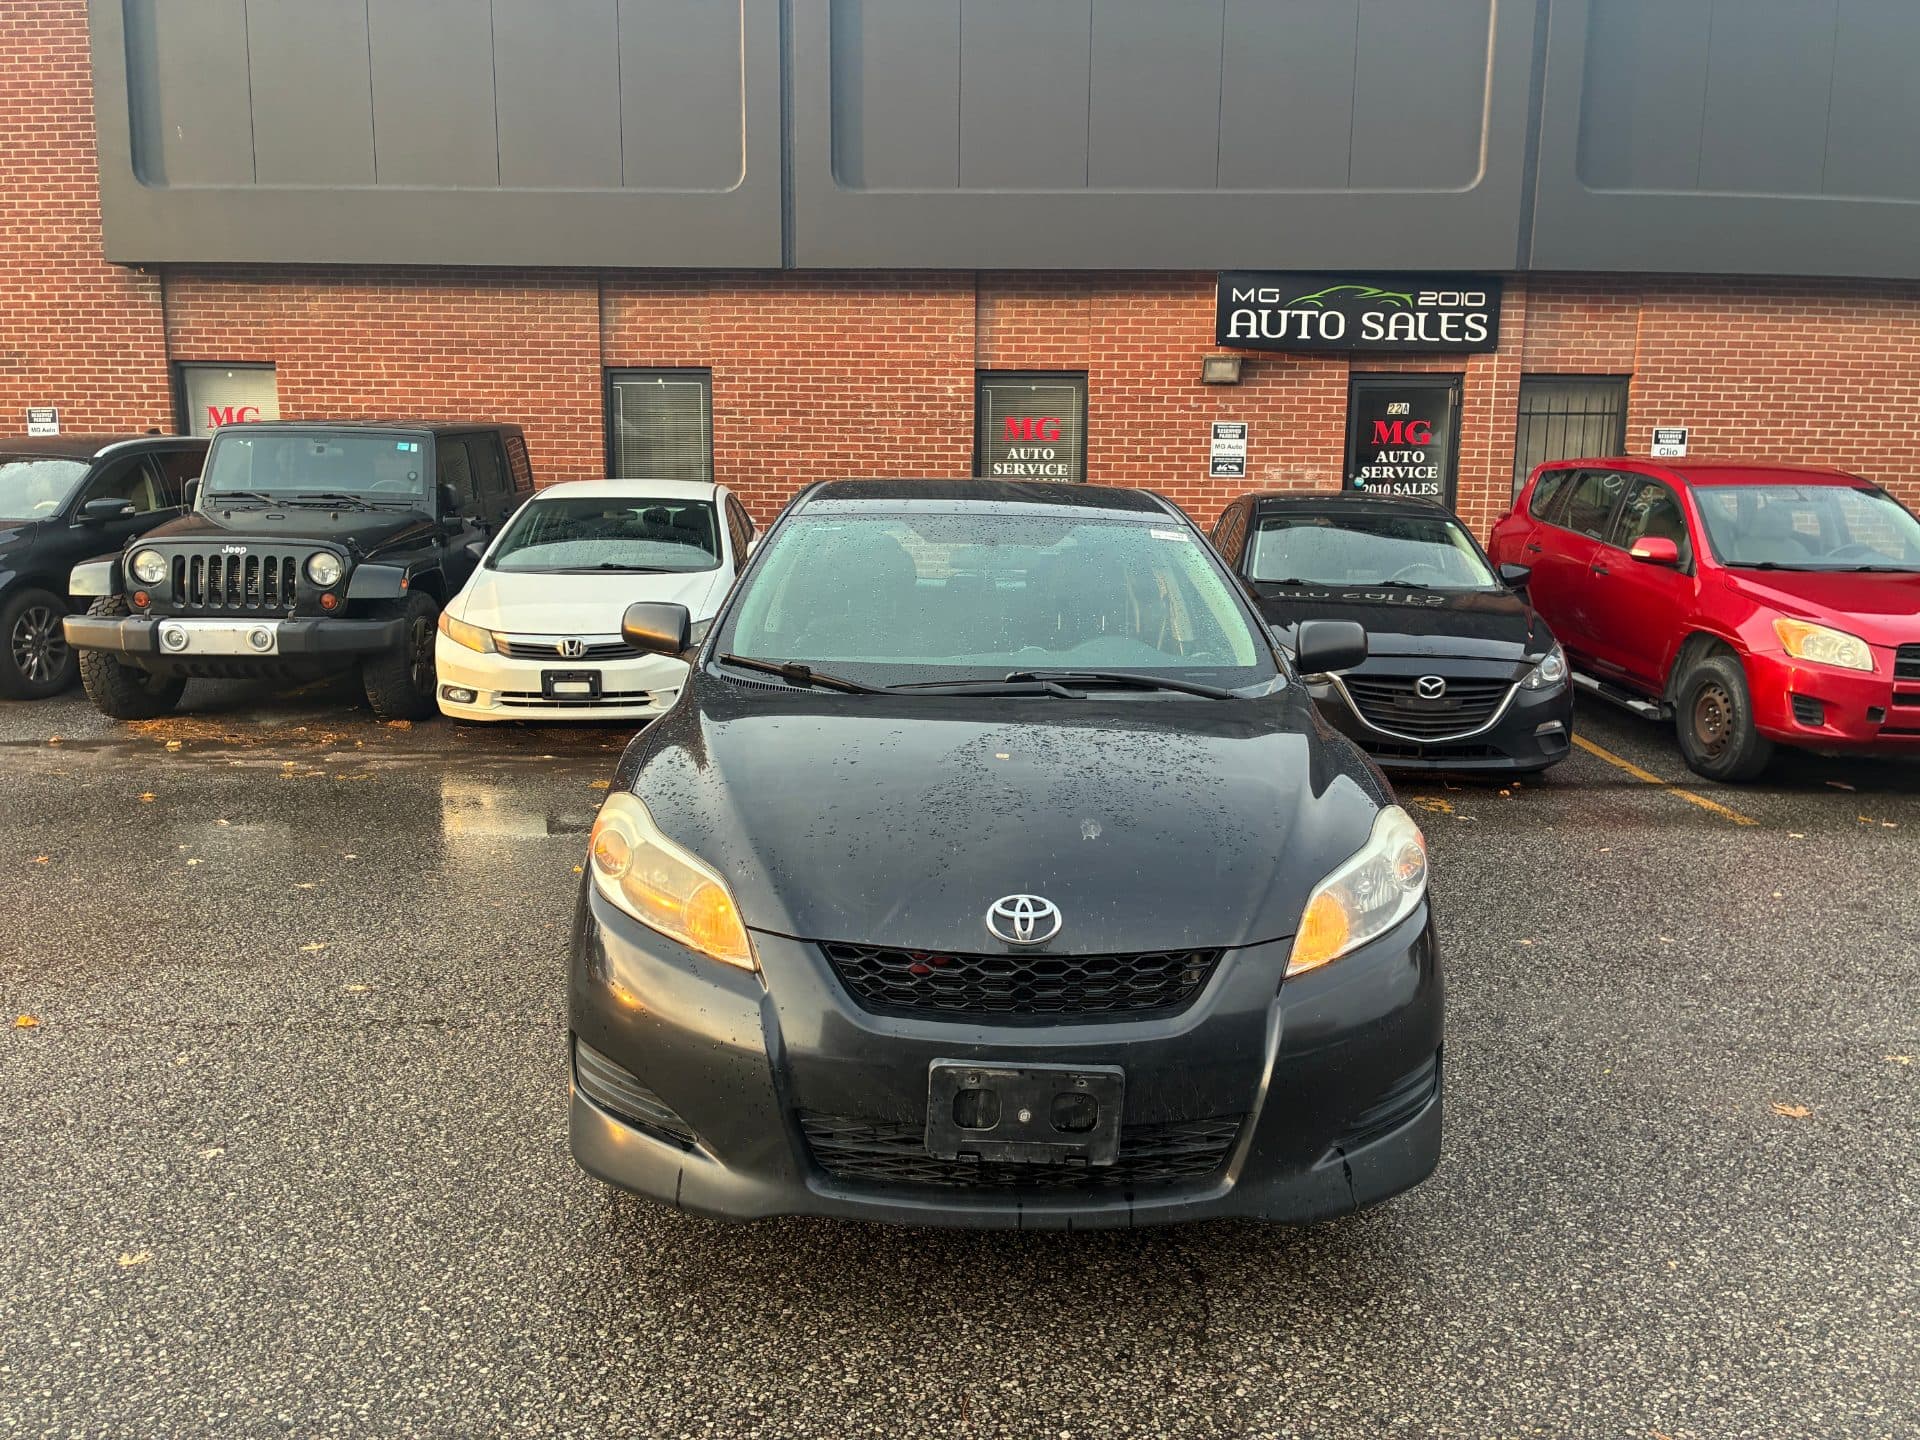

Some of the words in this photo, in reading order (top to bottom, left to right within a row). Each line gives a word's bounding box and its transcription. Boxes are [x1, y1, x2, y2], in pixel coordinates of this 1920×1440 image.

[1232, 287, 1280, 303] MG
[1417, 291, 1486, 307] 2010
[1226, 309, 1346, 340] AUTO
[1361, 311, 1488, 342] SALES
[1388, 403, 1409, 414] 22A
[206, 405, 262, 428] MG
[1002, 416, 1061, 442] MG
[1371, 420, 1432, 445] MG
[1007, 448, 1055, 460] AUTO
[1375, 450, 1425, 463] AUTO
[1659, 447, 1679, 456] Clio
[993, 462, 1068, 475] SERVICE
[1361, 466, 1438, 479] SERVICE
[1393, 483, 1439, 495] SALES
[221, 544, 247, 555] Jeep
